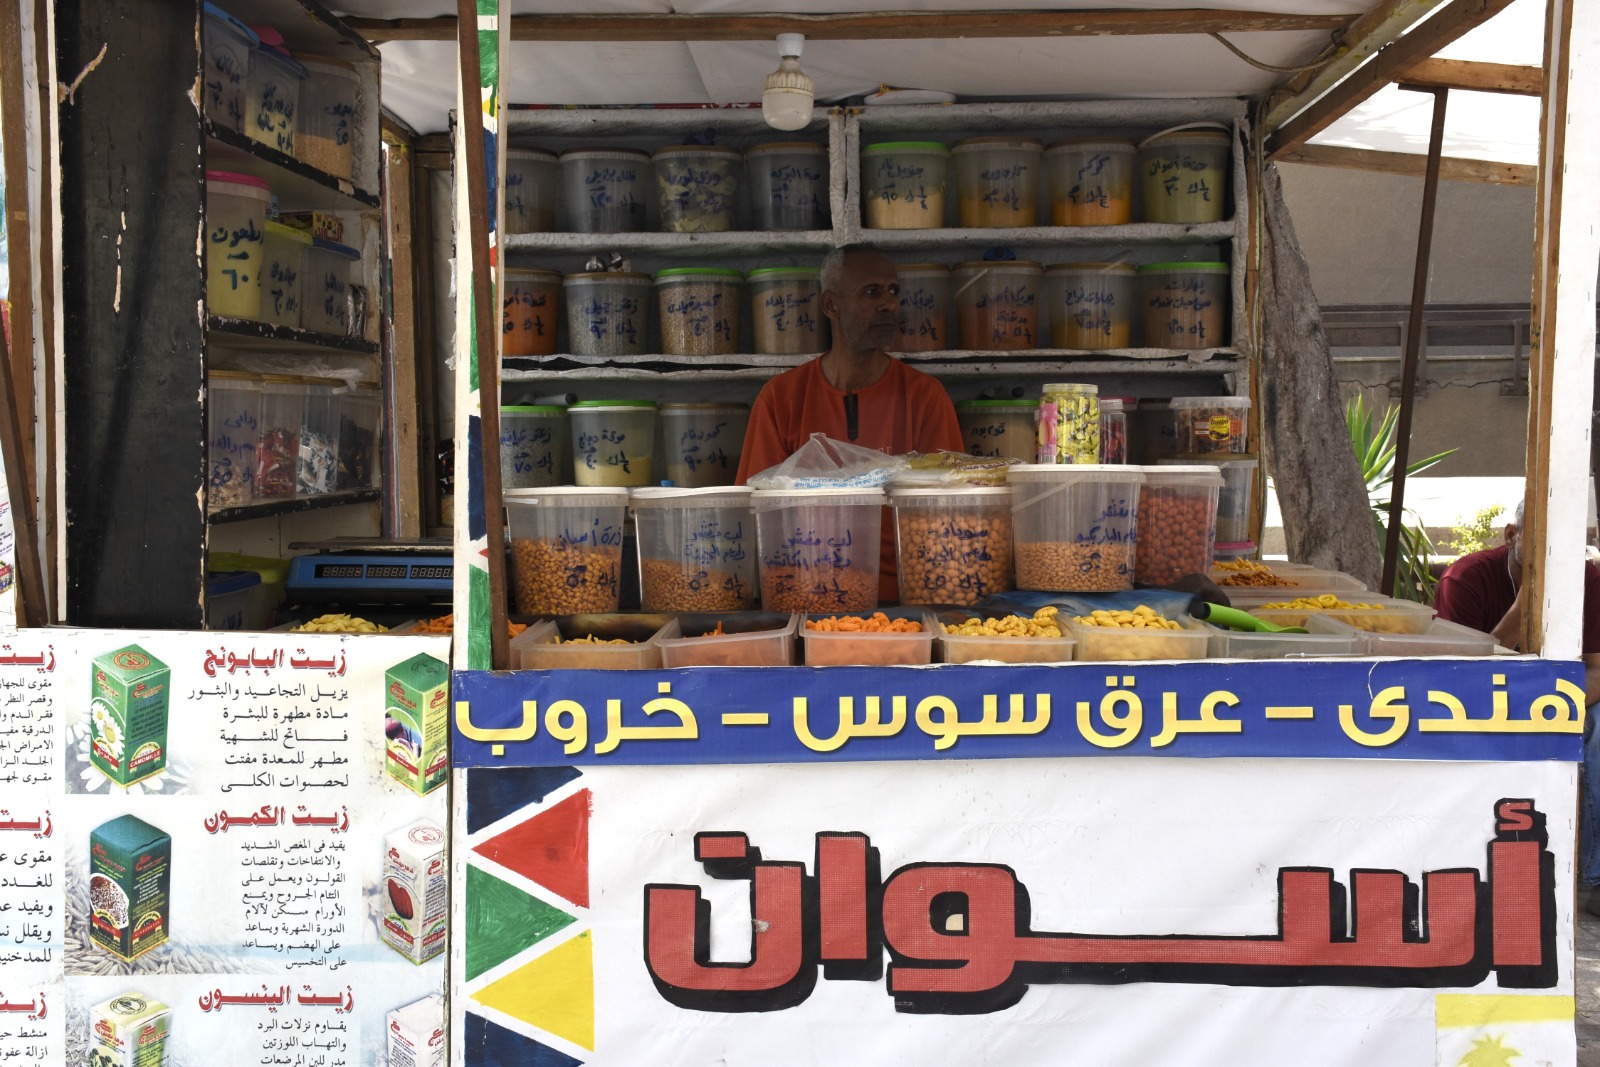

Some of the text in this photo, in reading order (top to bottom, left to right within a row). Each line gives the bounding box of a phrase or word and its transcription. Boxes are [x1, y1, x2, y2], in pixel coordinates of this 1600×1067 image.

[566, 573, 588, 588] ٥٠
[688, 578, 710, 591] ٥٠
[203, 646, 348, 677] زيت البابونج
[0, 677, 52, 691] مقوى للجها
[4, 693, 53, 706] وقصر النظر
[187, 682, 348, 702] يزيل التجاعيد والبثور
[10, 710, 33, 723] الدم
[37, 711, 53, 722] فقر
[223, 706, 348, 724] مادة مطهرة للبشرة
[1076, 675, 1243, 748] عرق
[1338, 673, 1585, 748] هندى
[454, 681, 699, 756] خروب
[792, 692, 1051, 753] سوس
[0, 726, 54, 737] الدرقية مفي
[220, 727, 348, 749] فاتح للشهية
[130, 749, 161, 767] CAMOMILLE
[225, 751, 348, 769] مطهر للمعدة مفتت
[23, 772, 52, 784] مقوى
[221, 771, 349, 792] لحصوات الكلى
[204, 805, 350, 834] زيت الكمون
[241, 839, 280, 851] الشديد
[284, 839, 311, 853] المغص
[329, 841, 346, 851] يفيد
[14, 850, 52, 868] مقوى
[241, 855, 284, 869] وتقلصات
[2, 874, 53, 887] للغدد
[241, 873, 345, 886] القولون ويعمل على
[242, 891, 273, 904] ويمنع
[276, 888, 316, 903] الجروح
[18, 900, 53, 917] ويفيد
[272, 903, 308, 918] مسكن
[315, 903, 345, 920] الأورام
[643, 797, 1558, 1015] أسوان
[15, 923, 52, 944] ويقلل
[245, 922, 345, 936] الدورة الشهرية ويساعد
[242, 938, 340, 953] على الهضم ويساعد
[0, 948, 51, 964] للمدخني
[286, 956, 347, 970] على التخسيس
[198, 984, 354, 1014] زيت الينسون
[17, 1026, 47, 1038] منشط
[257, 1018, 347, 1034] يقاوم نزلات البرد
[262, 1037, 347, 1052] والتهاب اللوزتين
[260, 1054, 305, 1067] المرضعات
